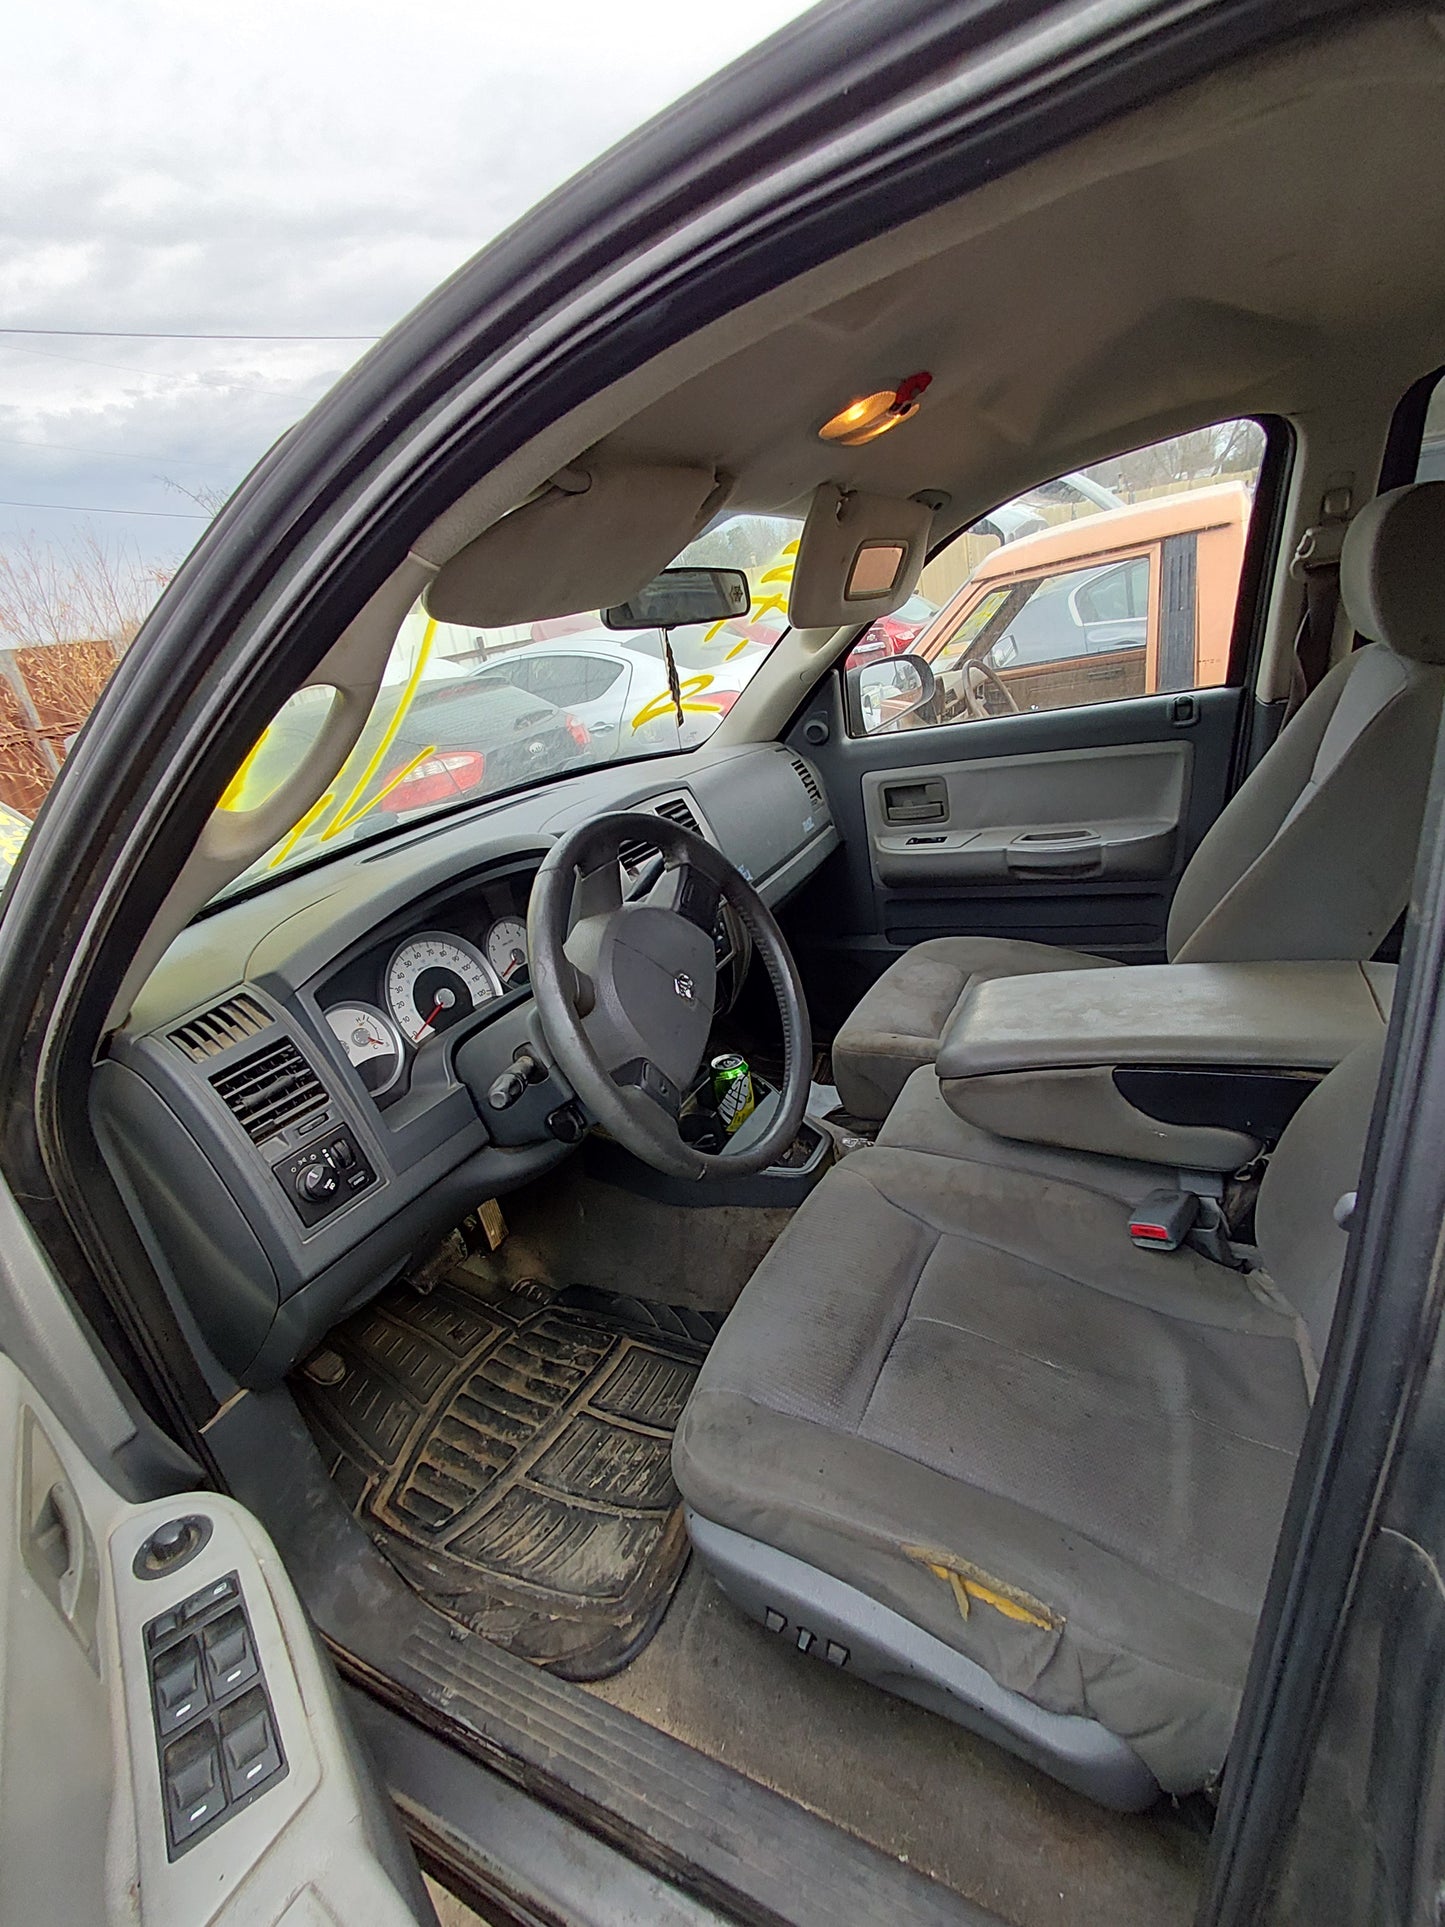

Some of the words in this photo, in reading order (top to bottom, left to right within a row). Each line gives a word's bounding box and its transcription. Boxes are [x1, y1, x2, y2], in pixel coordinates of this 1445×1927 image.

[414, 951, 422, 960] 60
[452, 955, 460, 963] 90
[404, 960, 413, 968] 50
[461, 963, 471, 971] 100
[397, 972, 405, 980] 40
[472, 974, 480, 982] 110
[395, 985, 404, 994] 30
[477, 989, 486, 997] 120
[396, 1001, 405, 1009] 20
[402, 1015, 410, 1024] 10
